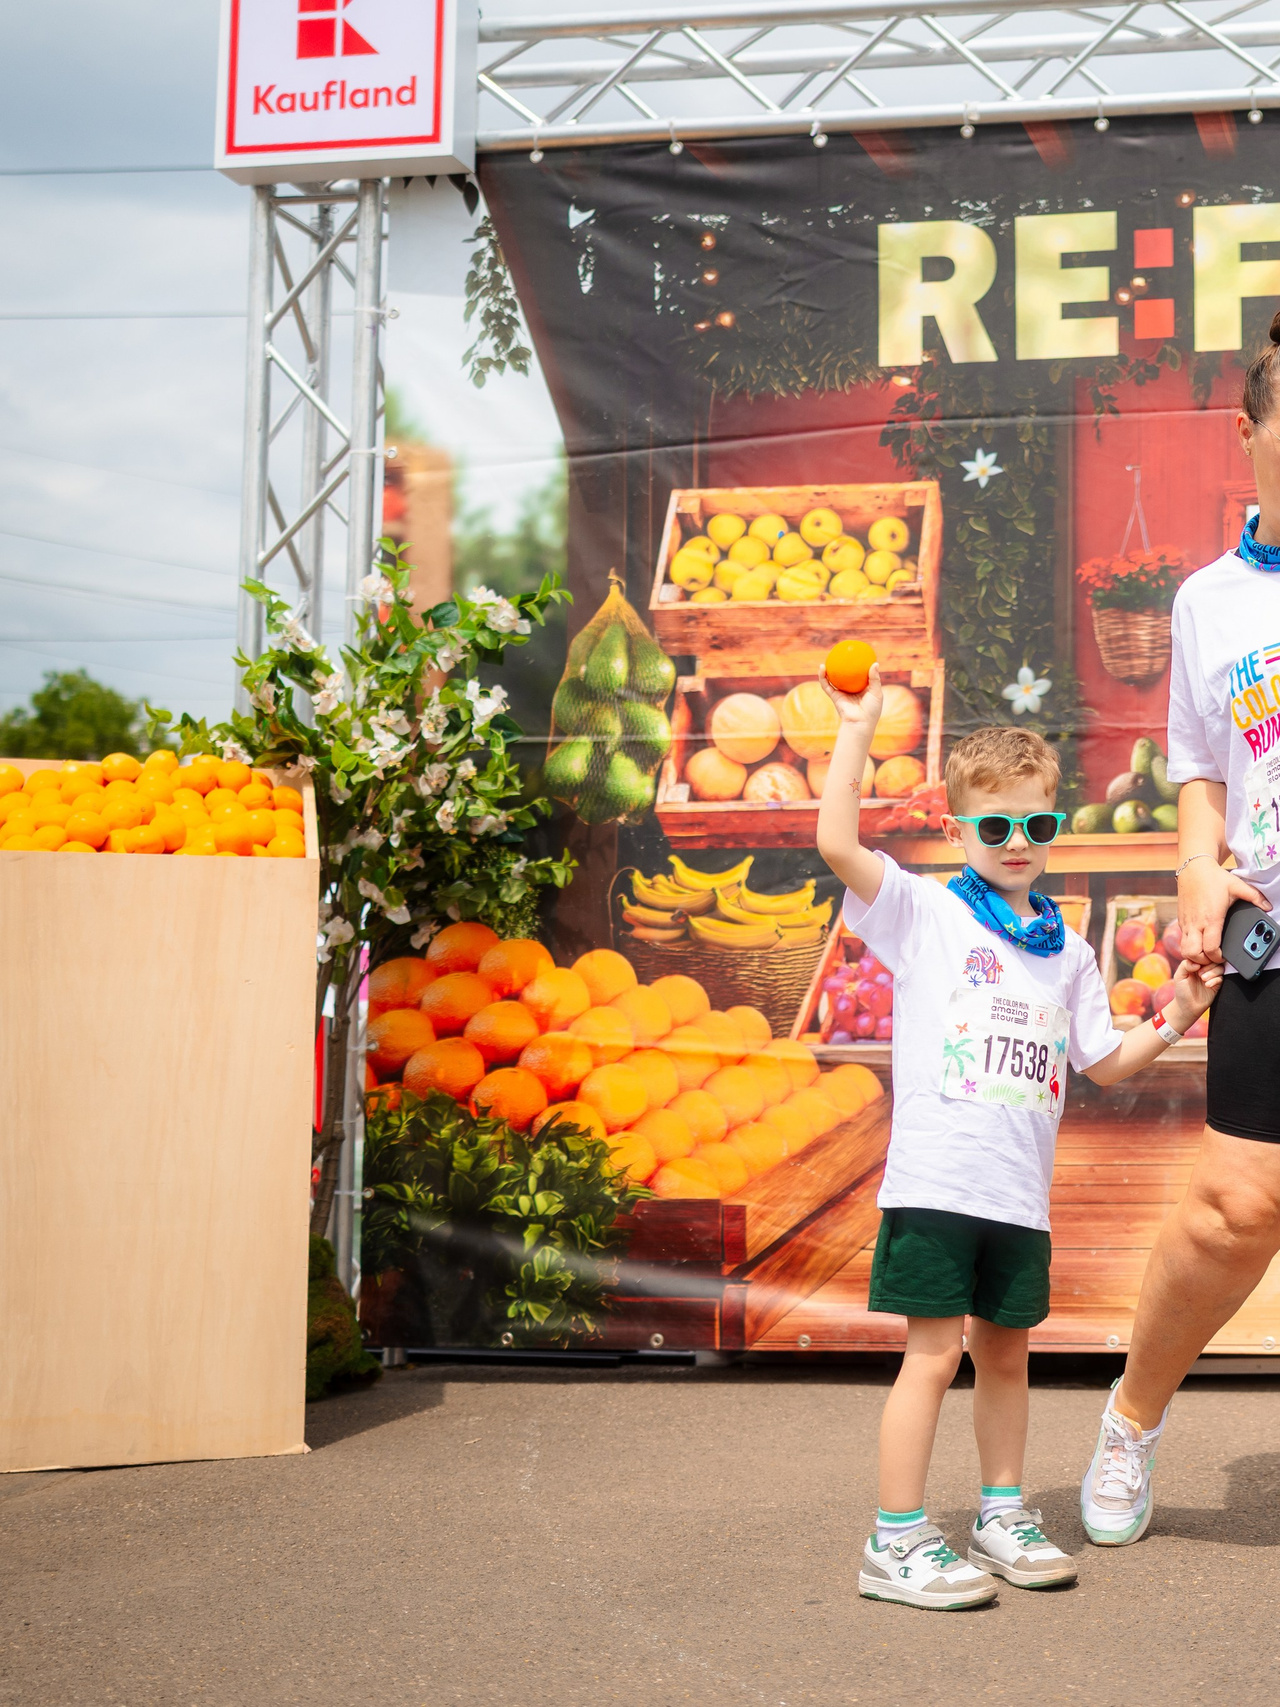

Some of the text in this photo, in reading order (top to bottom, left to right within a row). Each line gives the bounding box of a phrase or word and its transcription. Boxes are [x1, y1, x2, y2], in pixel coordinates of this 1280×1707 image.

[253, 75, 417, 115] Kaufland
[1229, 650, 1264, 698] THE
[991, 1005, 1029, 1020] amazing
[1002, 998, 1019, 1009] COLOR
[996, 1013, 1014, 1024] tour
[984, 1034, 1049, 1083] 17538
